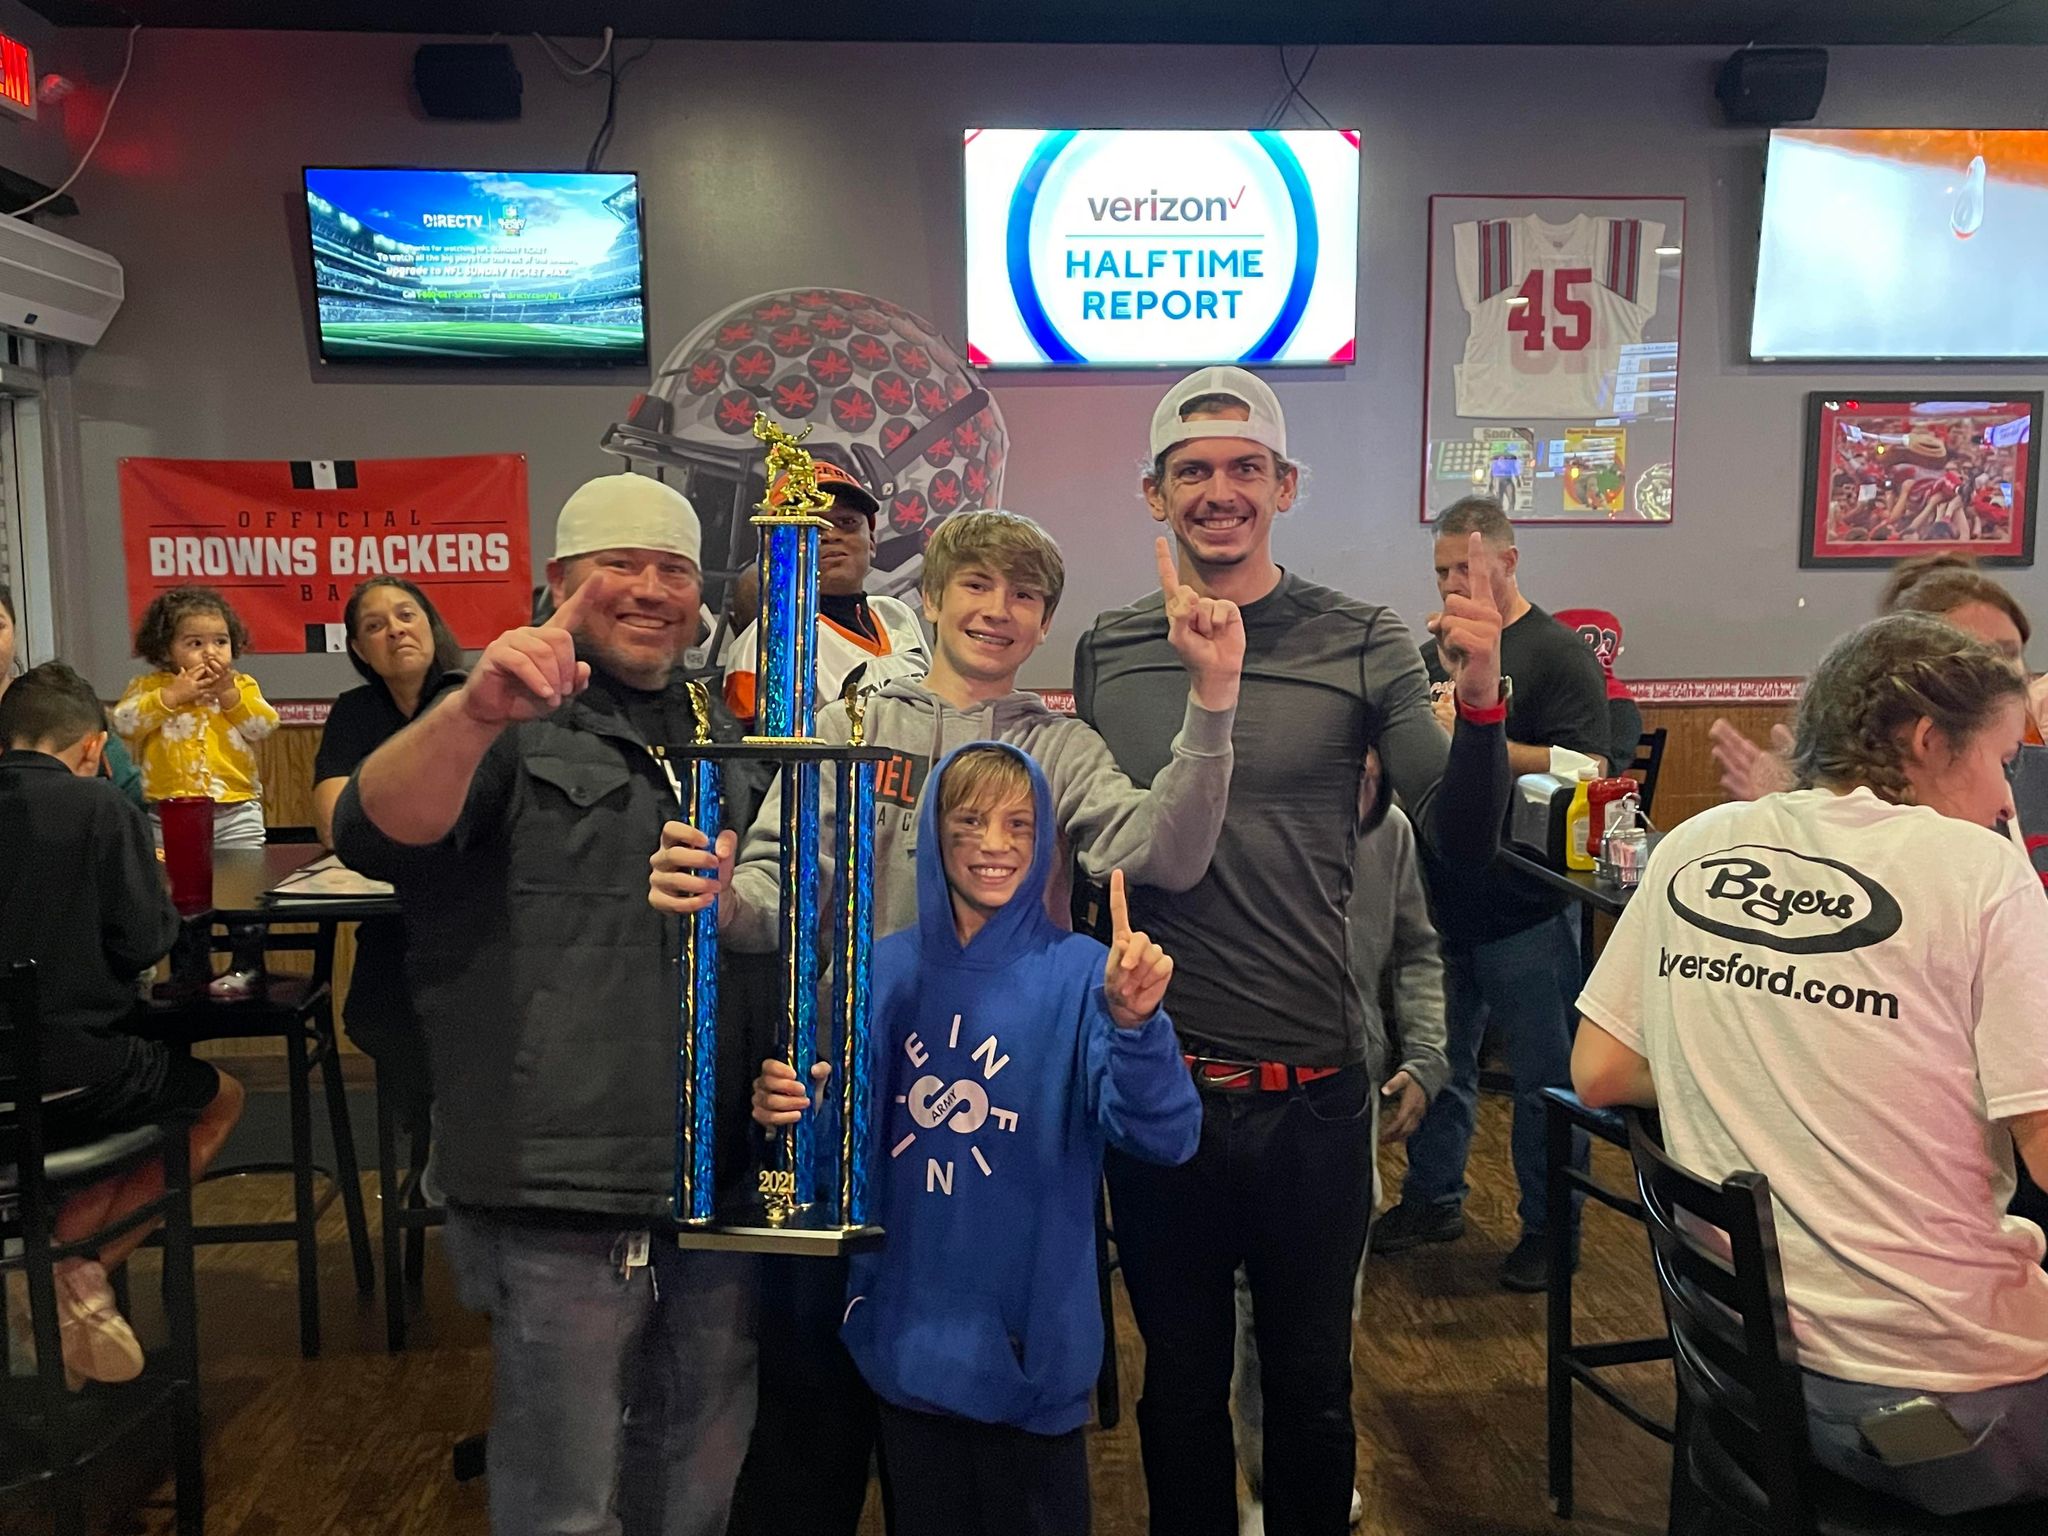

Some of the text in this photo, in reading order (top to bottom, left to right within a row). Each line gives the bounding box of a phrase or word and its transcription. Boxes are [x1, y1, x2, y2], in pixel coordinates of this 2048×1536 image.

[422, 213, 483, 229] DIRECTV
[1087, 188, 1228, 222] verizon
[1066, 249, 1264, 278] HALFTIME
[1083, 290, 1243, 320] REPORT
[1507, 268, 1592, 351] 45
[239, 509, 421, 529] OFFICIAL
[150, 532, 510, 576] BROWNS BACKERS
[1701, 857, 1855, 926] Byers
[931, 1088, 958, 1123] ARMY
[758, 1170, 796, 1193] 2021
